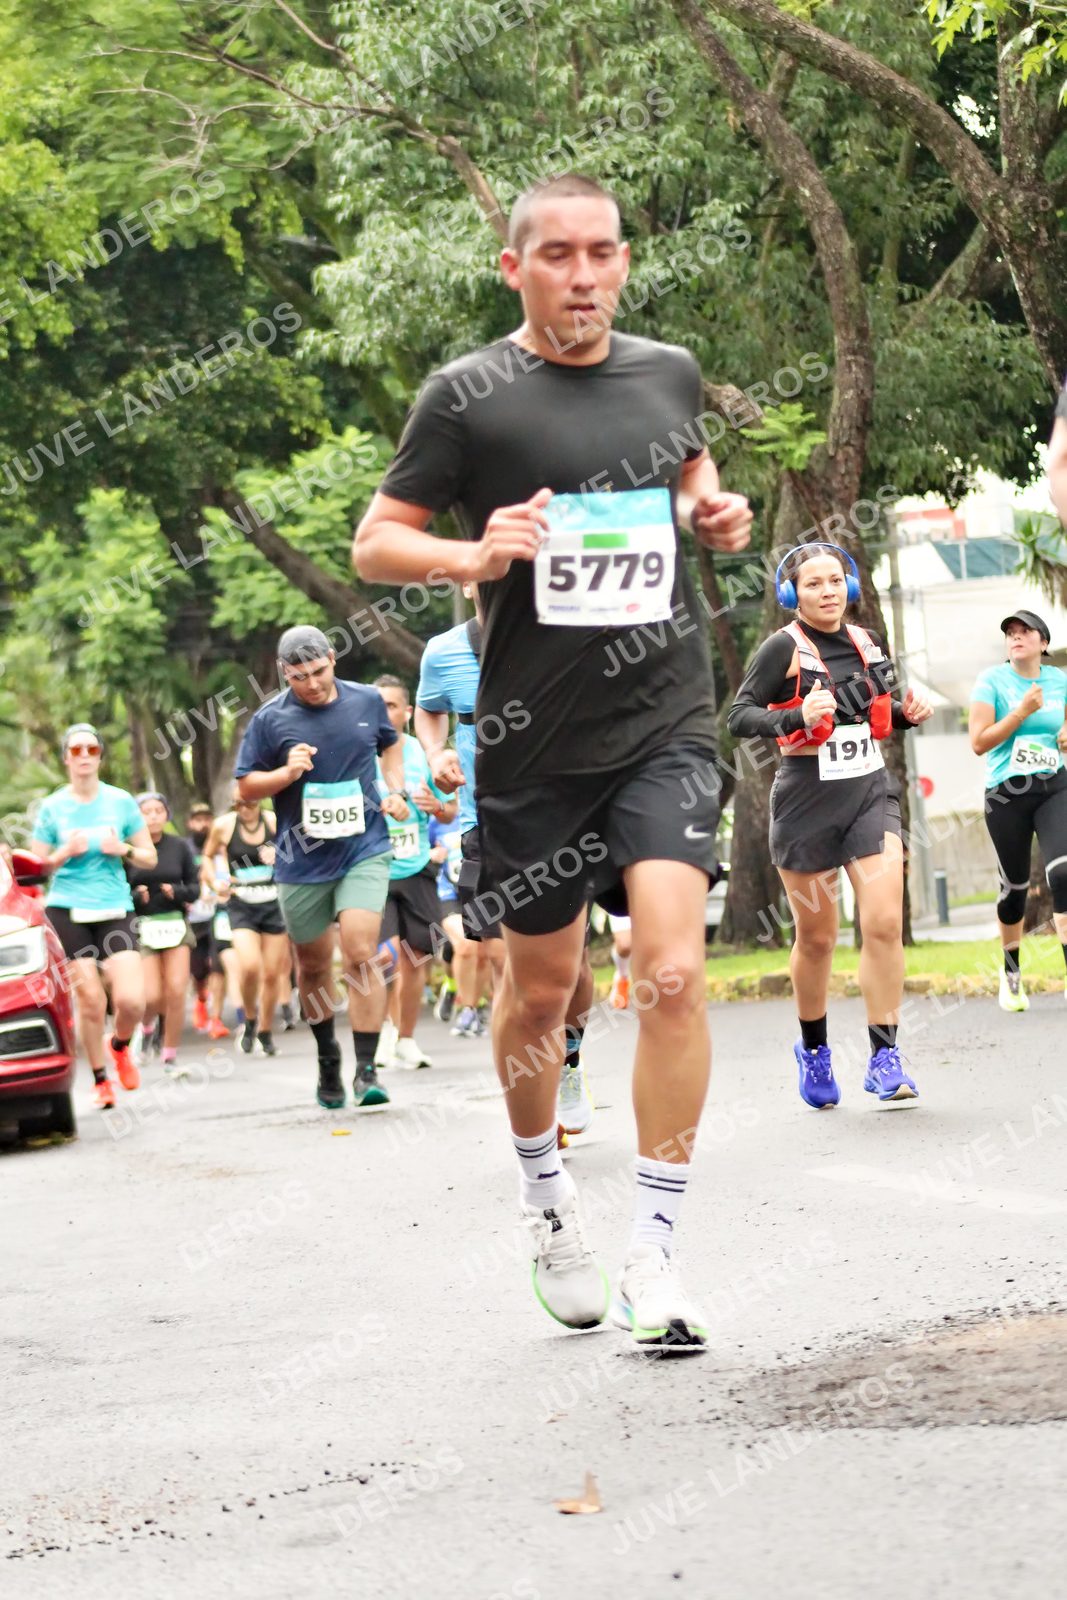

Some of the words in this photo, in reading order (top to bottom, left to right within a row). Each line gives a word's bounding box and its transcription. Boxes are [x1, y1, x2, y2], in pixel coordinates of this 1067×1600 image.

[548, 551, 664, 592] 5779
[826, 738, 875, 762] 191
[309, 806, 358, 824] 5905
